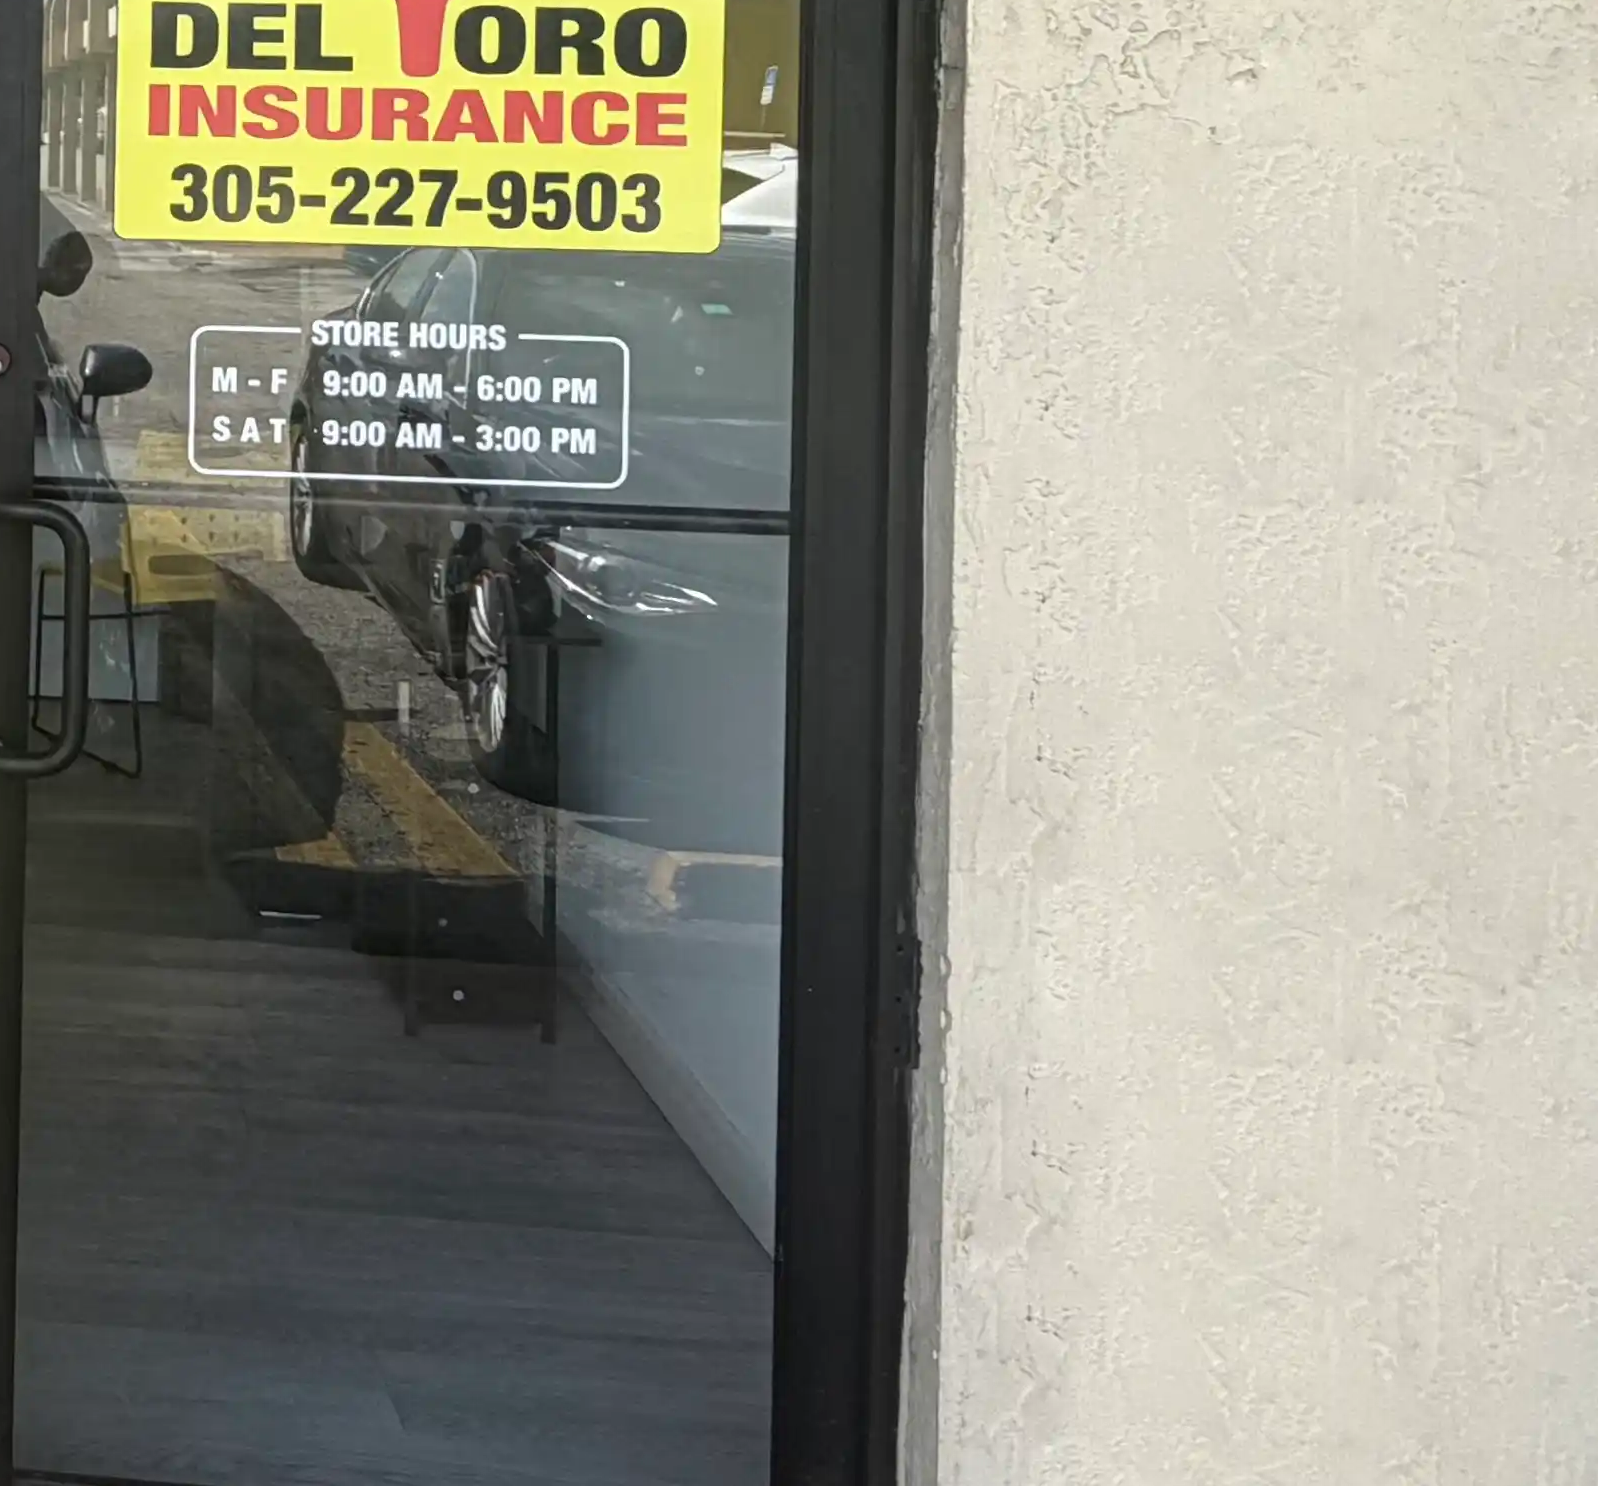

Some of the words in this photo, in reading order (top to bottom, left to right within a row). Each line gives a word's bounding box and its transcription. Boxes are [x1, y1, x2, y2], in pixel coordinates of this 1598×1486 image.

[150, 1, 354, 71] DEL
[147, 84, 688, 147] INSURANCE
[169, 164, 663, 233] 305-227-9503
[311, 320, 399, 347] STORE
[409, 322, 507, 351] HOURS
[323, 370, 387, 397] 9:00
[396, 373, 443, 399] AM
[477, 375, 542, 402] 6:00
[552, 378, 597, 405] PM
[322, 419, 386, 446] 9:00
[395, 422, 442, 449] AM
[475, 425, 541, 452] 3:00
[551, 427, 596, 455] PM
